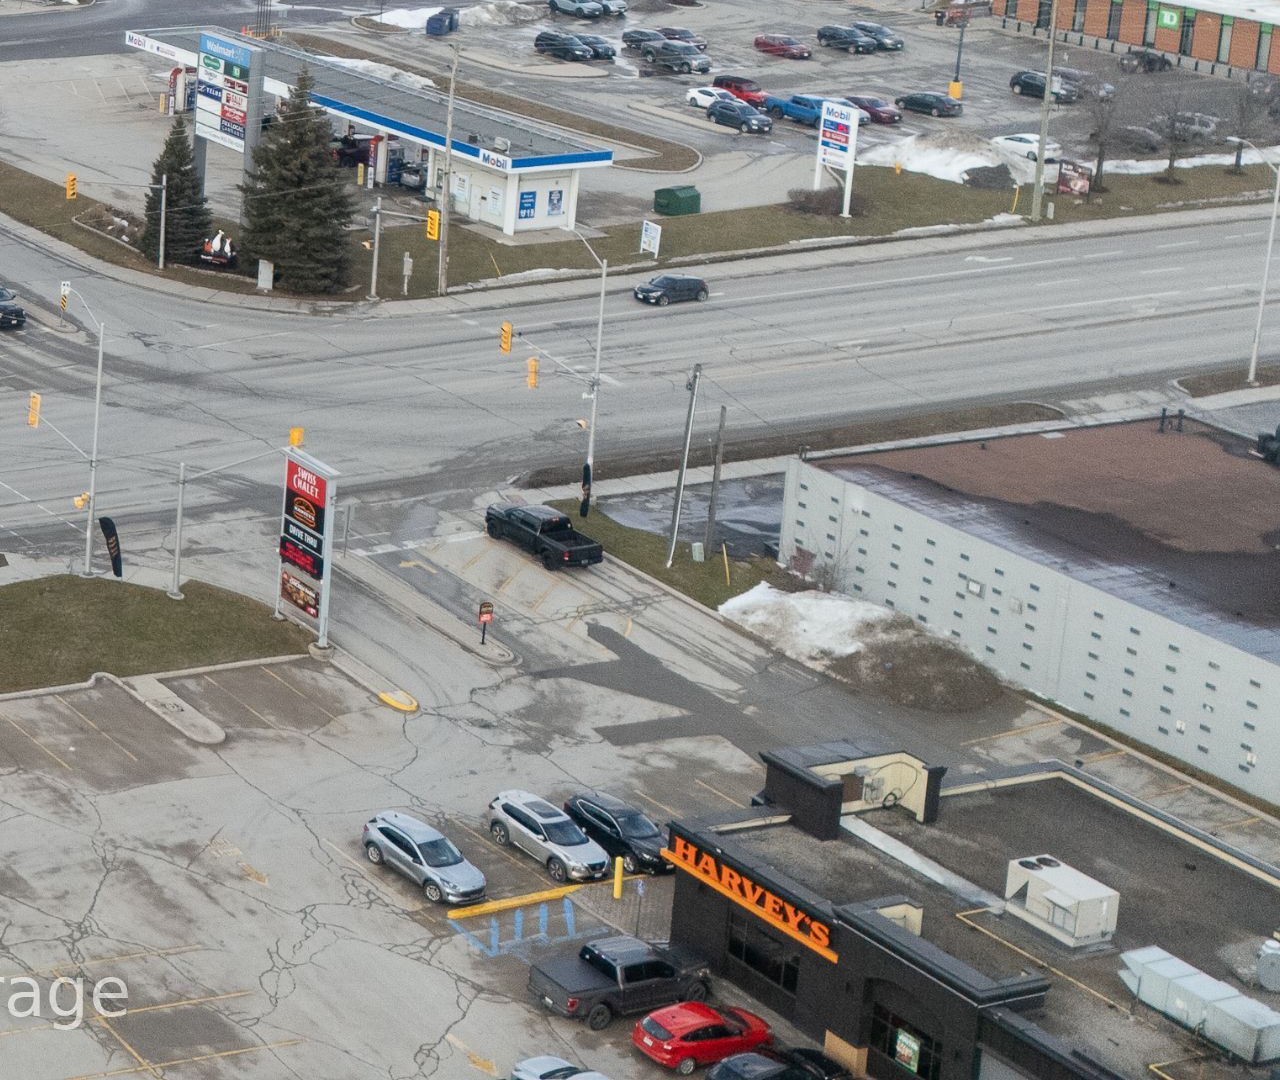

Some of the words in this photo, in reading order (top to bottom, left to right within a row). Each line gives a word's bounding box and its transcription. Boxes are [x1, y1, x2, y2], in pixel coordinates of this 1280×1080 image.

[1162, 11, 1177, 25] TD
[128, 35, 146, 49] Mobil
[206, 40, 235, 57] Walmart
[826, 106, 851, 121] Mobil
[482, 152, 508, 170] Mobil
[298, 466, 317, 486] SWISS
[293, 474, 319, 499] CHALET
[289, 524, 304, 540] DRIVE
[304, 532, 318, 548] THRU
[674, 835, 831, 948] HARVEY'S
